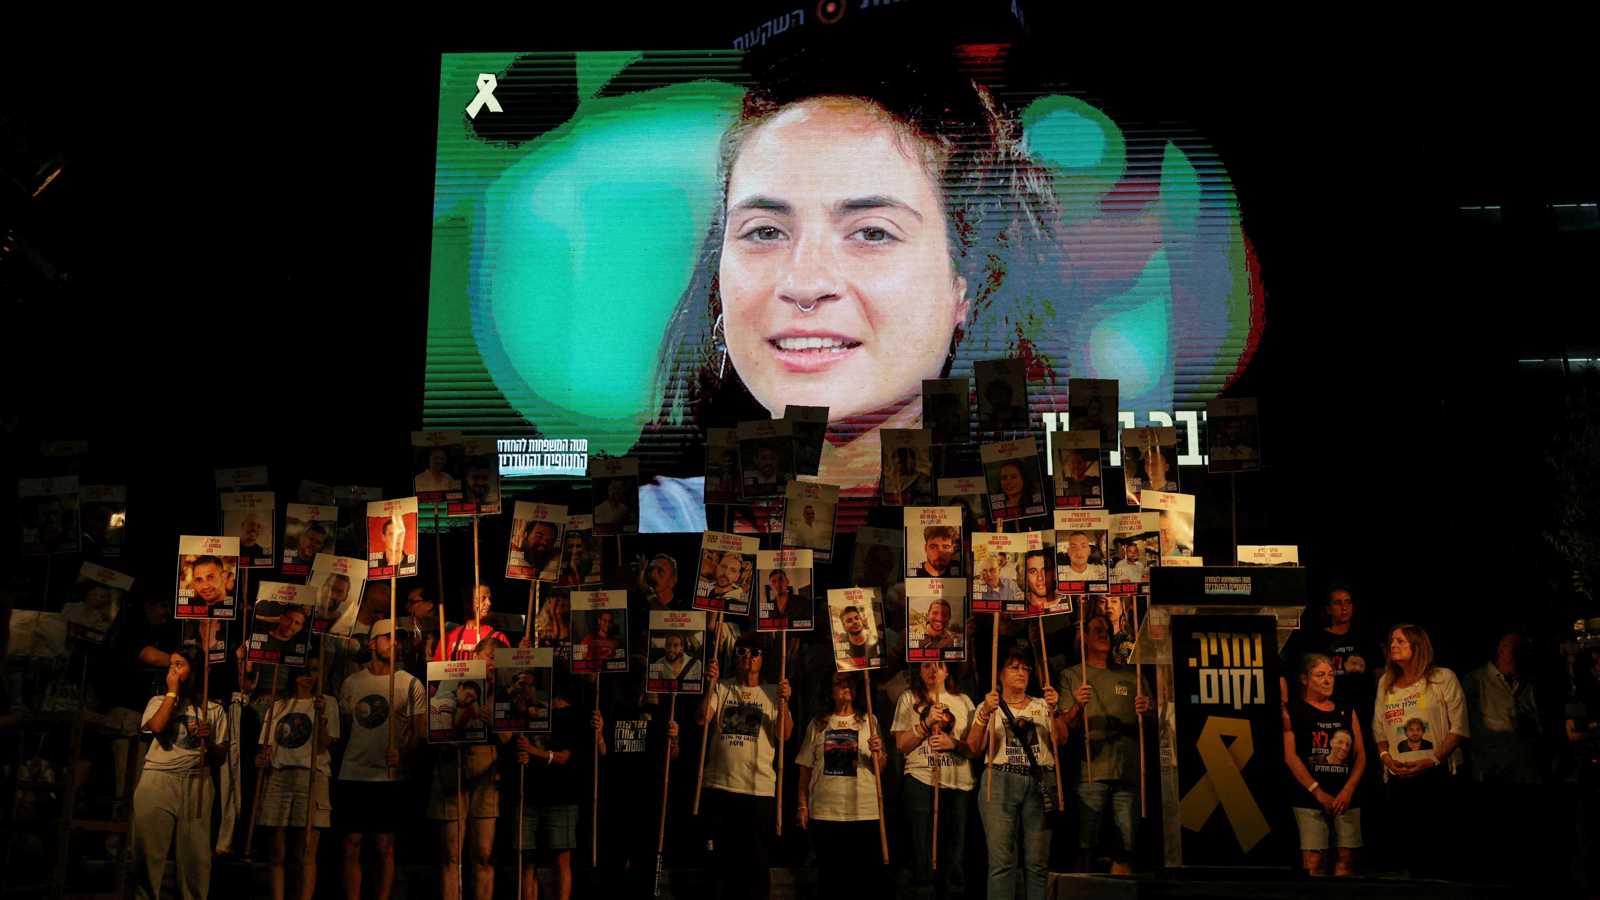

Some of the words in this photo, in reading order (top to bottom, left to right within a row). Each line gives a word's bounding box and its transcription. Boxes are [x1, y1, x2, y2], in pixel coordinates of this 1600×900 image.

[732, 9, 804, 50] השקעות
[528, 439, 569, 452] המשפחות
[570, 439, 588, 452] מטה
[544, 453, 587, 469] החטופים
[1188, 632, 1263, 667] נחזיר.
[1191, 669, 1266, 710] נקום.
